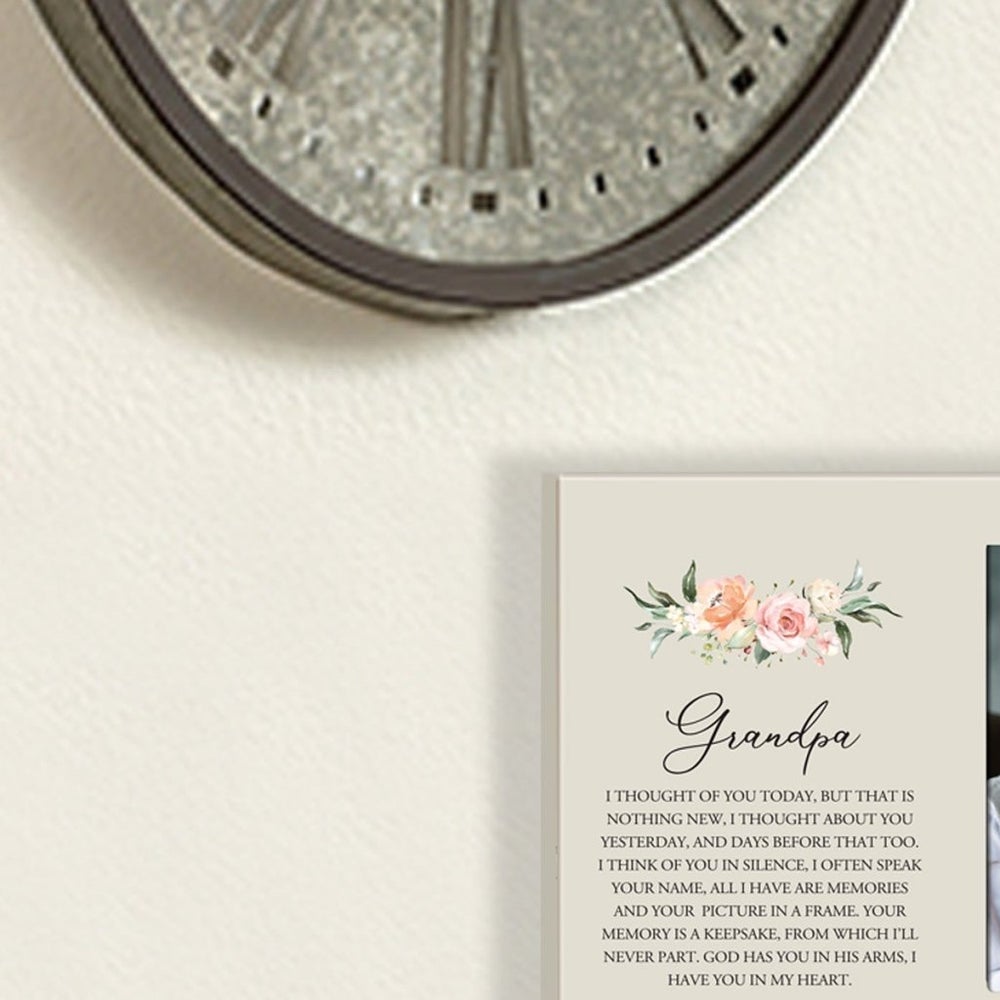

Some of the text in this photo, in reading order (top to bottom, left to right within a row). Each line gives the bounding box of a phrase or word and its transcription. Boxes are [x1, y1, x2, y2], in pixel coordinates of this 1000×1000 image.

[662, 691, 862, 776] Grandpa
[605, 789, 915, 804] I THOUGHT OF YOU TODAY, BUT THAT IS
[607, 812, 914, 826] NOTHING NEW, I THOUGHT ABOUT YOU
[600, 835, 920, 849] YESTERDAY, AND DAYS BEFORE THAT TOO.
[598, 858, 923, 873] I THINK OF YOU IN SILENCE, I OFTEN SPEAK
[611, 881, 909, 895] YOUR NAME, ALL I HAVE ARE MEMORIES
[613, 904, 907, 918] AND YOUR PICTURE IN A FRAME. YOUR
[601, 927, 919, 941] MEMORY IS A KEEPSAKE, FROM WHICH I'LL
[603, 950, 917, 964] NEVER PART. GOD HAS YOU IN HIS ARMS, I
[667, 973, 853, 987] HAVE YOU IN MY HEART.
